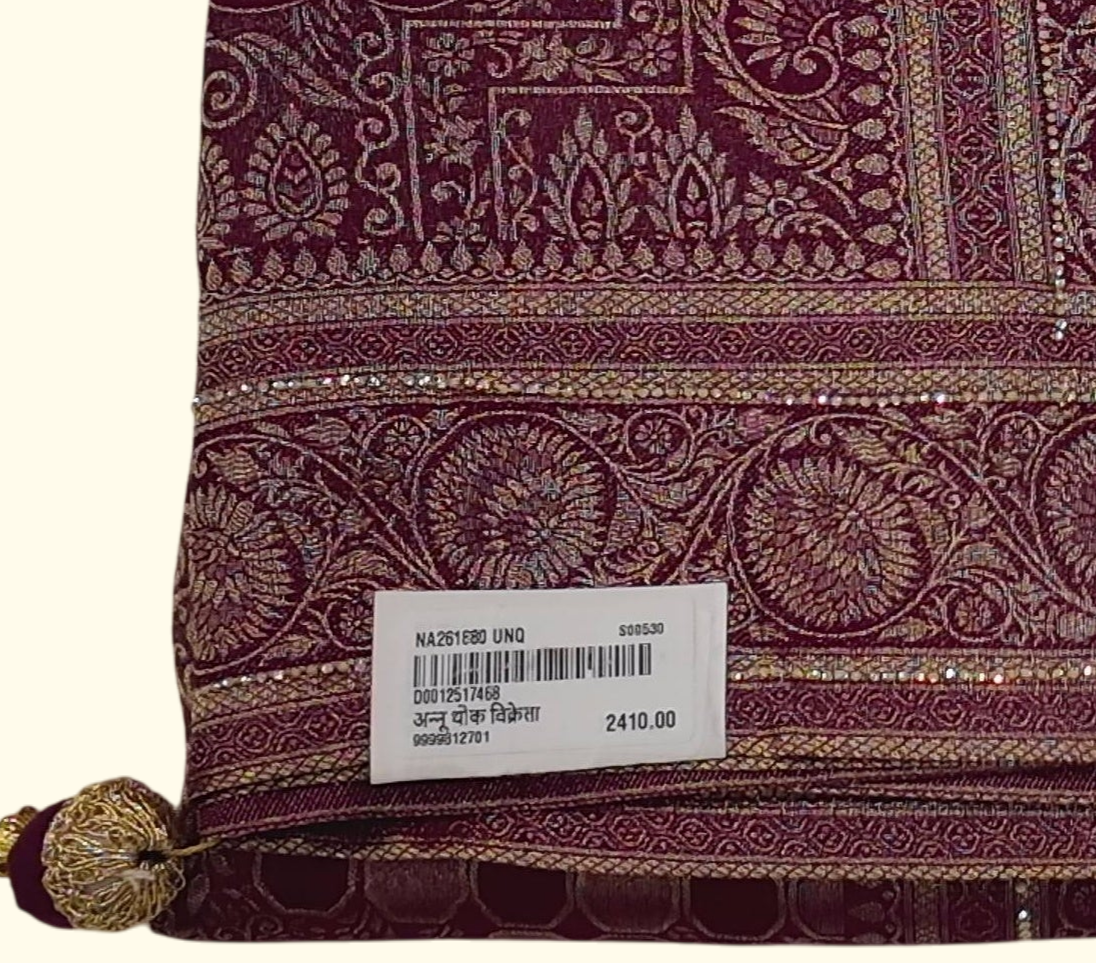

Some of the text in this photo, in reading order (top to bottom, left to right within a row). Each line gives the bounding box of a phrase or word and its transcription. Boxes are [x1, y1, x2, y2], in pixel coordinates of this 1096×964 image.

[493, 627, 525, 644] UNQ
[490, 701, 540, 724] विक्रेता
[606, 710, 676, 732] 2410.00
